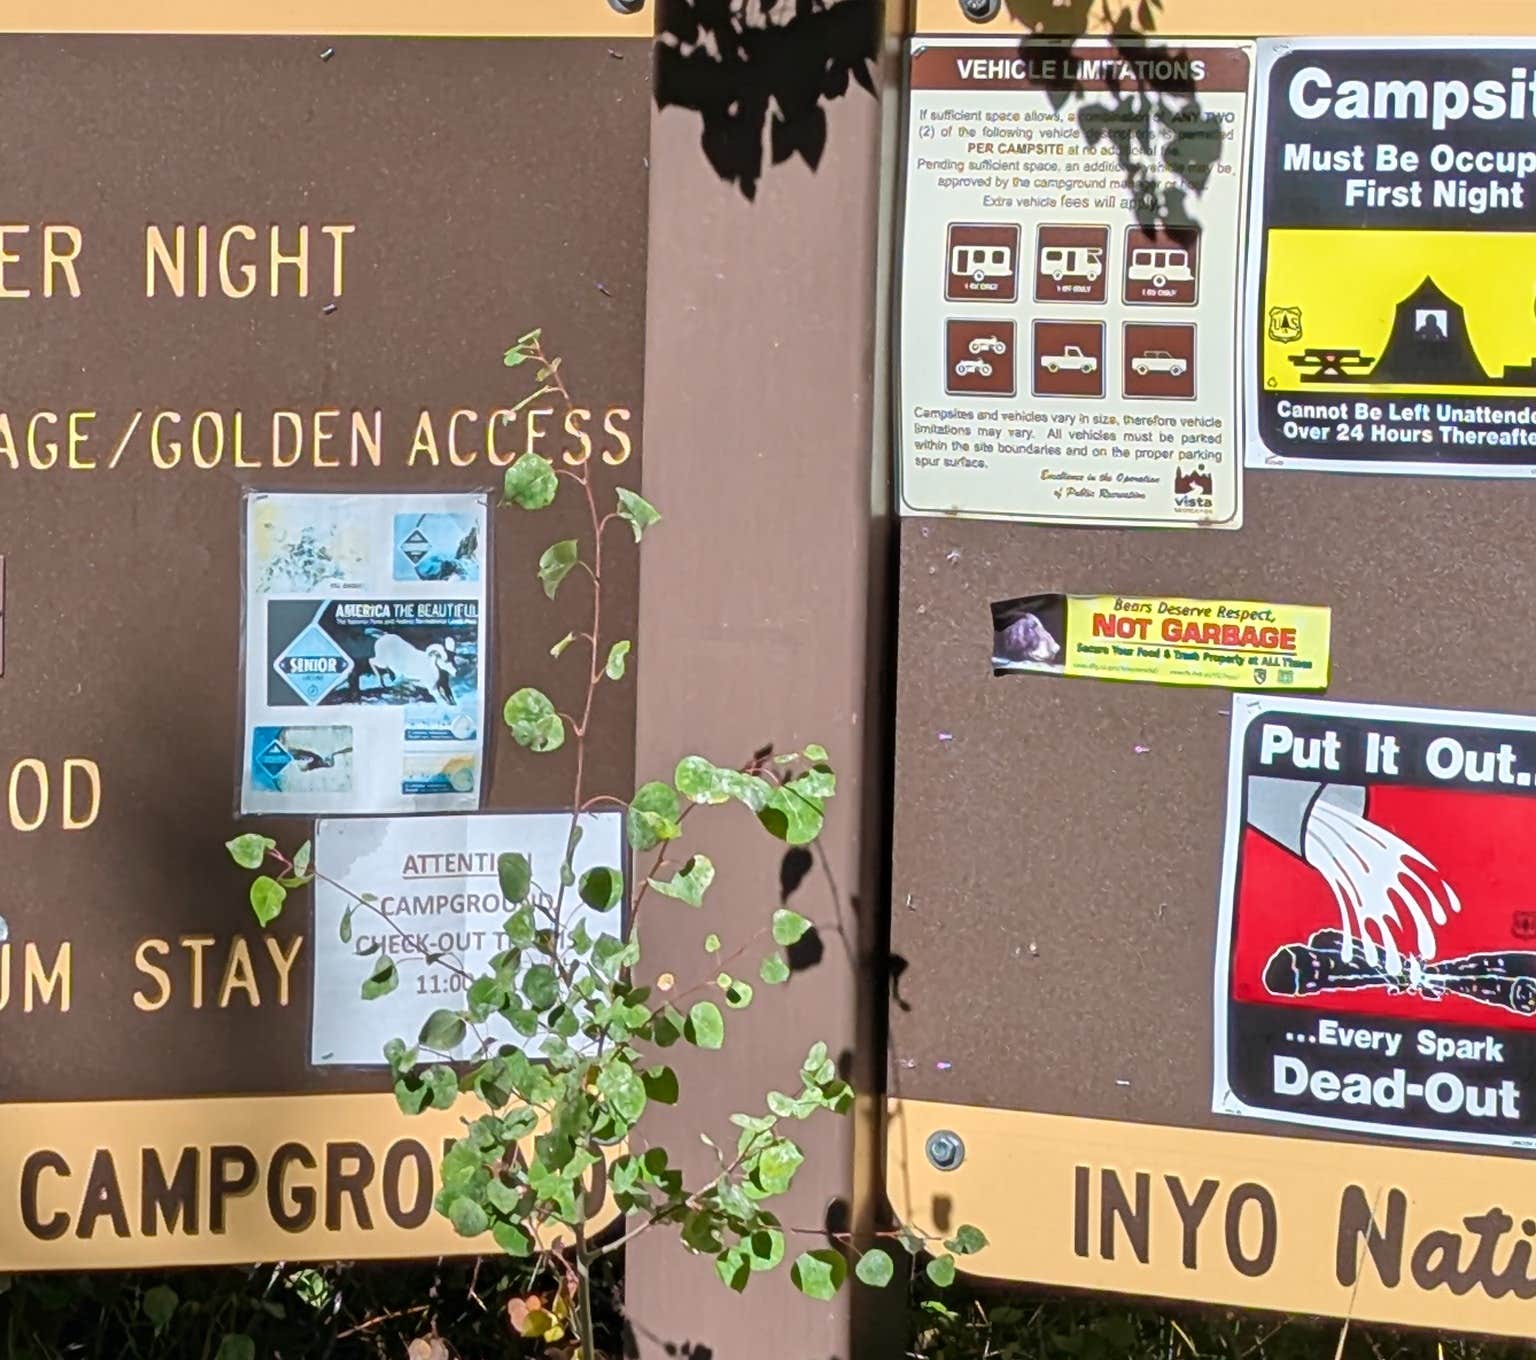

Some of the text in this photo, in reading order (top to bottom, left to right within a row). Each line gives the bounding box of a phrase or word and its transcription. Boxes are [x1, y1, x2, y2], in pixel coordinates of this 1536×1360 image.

[957, 59, 1205, 80] VEHICLE LIMITATIONS
[1288, 66, 1536, 130] Campsi
[931, 110, 982, 122] sufficient
[986, 112, 1020, 124] space
[1203, 112, 1236, 124] TWO
[941, 126, 953, 137] of
[958, 126, 976, 138] the
[982, 126, 1033, 141] following
[967, 142, 994, 154] PER
[997, 143, 1064, 156] CAMPSITE
[1283, 143, 1365, 172] Must
[1375, 144, 1419, 172] Be
[917, 158, 964, 173] Pending
[968, 159, 1020, 171] sufficient
[938, 176, 1106, 192] approved by the campground
[983, 194, 1116, 208] Extra vehicle fees will
[1345, 179, 1524, 214] First Night
[145, 223, 357, 299] NIGHT
[914, 406, 974, 422] Campsites
[977, 409, 998, 421] and
[1001, 409, 1048, 423] vehicles
[1051, 412, 1076, 426] vary
[1079, 413, 1090, 424] in
[1123, 415, 1177, 427] therefore
[1180, 415, 1223, 428] vehicle
[1277, 400, 1348, 420] Cannot
[1355, 402, 1383, 421] Be
[1389, 403, 1431, 422] Left
[406, 407, 632, 467] ACCESS
[914, 423, 972, 436] limitations
[977, 426, 1002, 439] may
[1047, 427, 1062, 440] All
[1069, 430, 1116, 442] vehicles
[1123, 431, 1153, 443] must
[1159, 431, 1174, 443] be
[1181, 432, 1222, 446] parked
[1283, 422, 1331, 439] Over
[1336, 424, 1364, 441] 24
[1371, 424, 1433, 443] Hours
[914, 439, 1223, 464] within the site boundaries and on the proper parking
[915, 457, 940, 469] spur
[1174, 495, 1213, 508] vista
[335, 603, 479, 618] AMERICA THE BEAUTIFUL
[1114, 598, 1276, 623] Bears Deserve Respect,
[1092, 613, 1297, 651] NOT GARBAGE
[289, 657, 338, 673] SENIOR
[1137, 646, 1161, 659] Food
[1261, 656, 1280, 667] ALL
[1259, 723, 1536, 788] Put It Out.
[403, 852, 532, 874] ATTENTI
[356, 931, 486, 957] CHECK-OUT
[132, 935, 304, 1011] STAY
[1417, 1027, 1505, 1063] Spark
[1273, 1054, 1520, 1120] Dead-Out
[1074, 1165, 1536, 1300] INYO Nati
